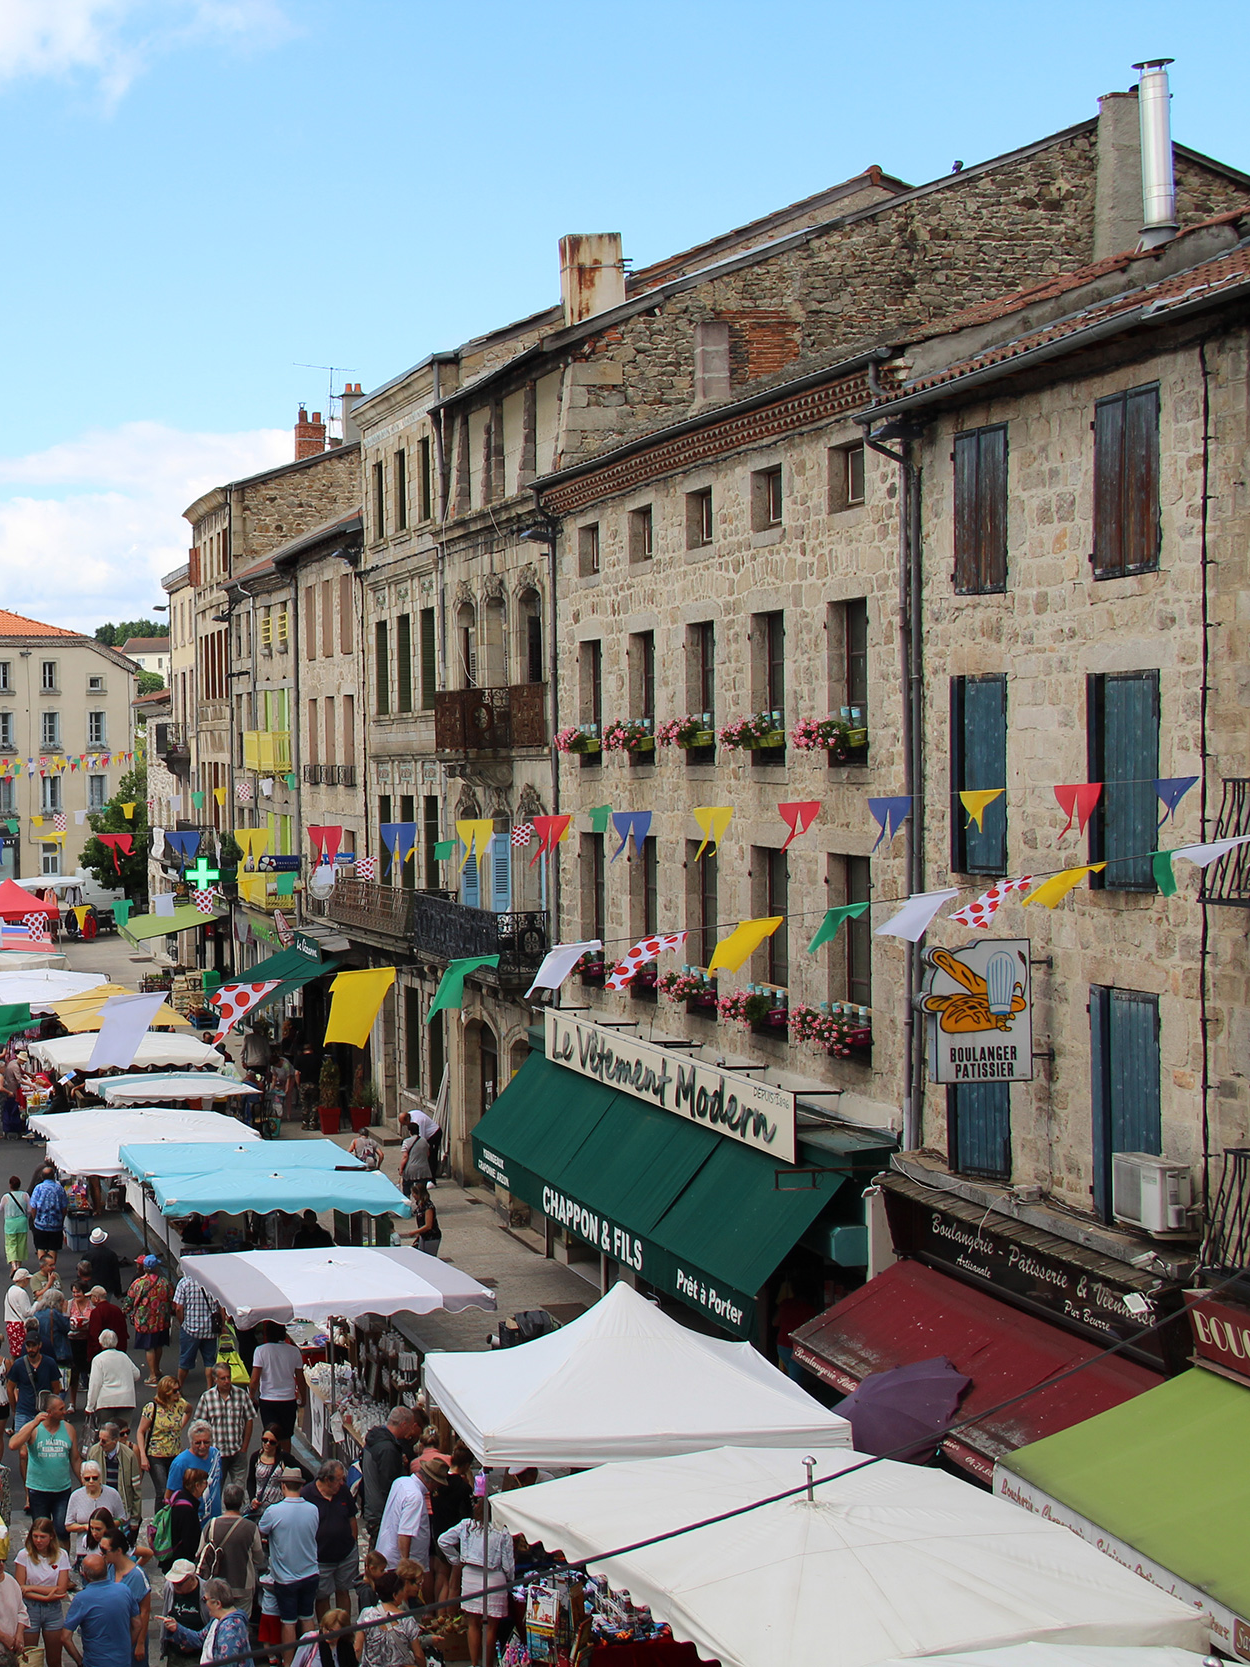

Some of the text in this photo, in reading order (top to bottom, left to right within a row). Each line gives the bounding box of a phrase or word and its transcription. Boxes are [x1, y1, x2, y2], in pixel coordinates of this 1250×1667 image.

[950, 1045, 1017, 1063] BOULANGER
[955, 1062, 1014, 1079] PATISSIER
[552, 1018, 777, 1144] Le Vêtement Modern
[753, 1086, 773, 1104] DEPUIS
[542, 1185, 643, 1271] CHAPPON & FILS
[931, 1213, 994, 1257] Boulangerie
[1008, 1244, 1069, 1289] Pâtisserie
[1076, 1275, 1088, 1299] &
[956, 1253, 992, 1279] Artisanale
[676, 1268, 744, 1326] Prêt à Porter
[1064, 1299, 1111, 1332] Pur Beurre
[794, 1346, 837, 1381] Boulangerie
